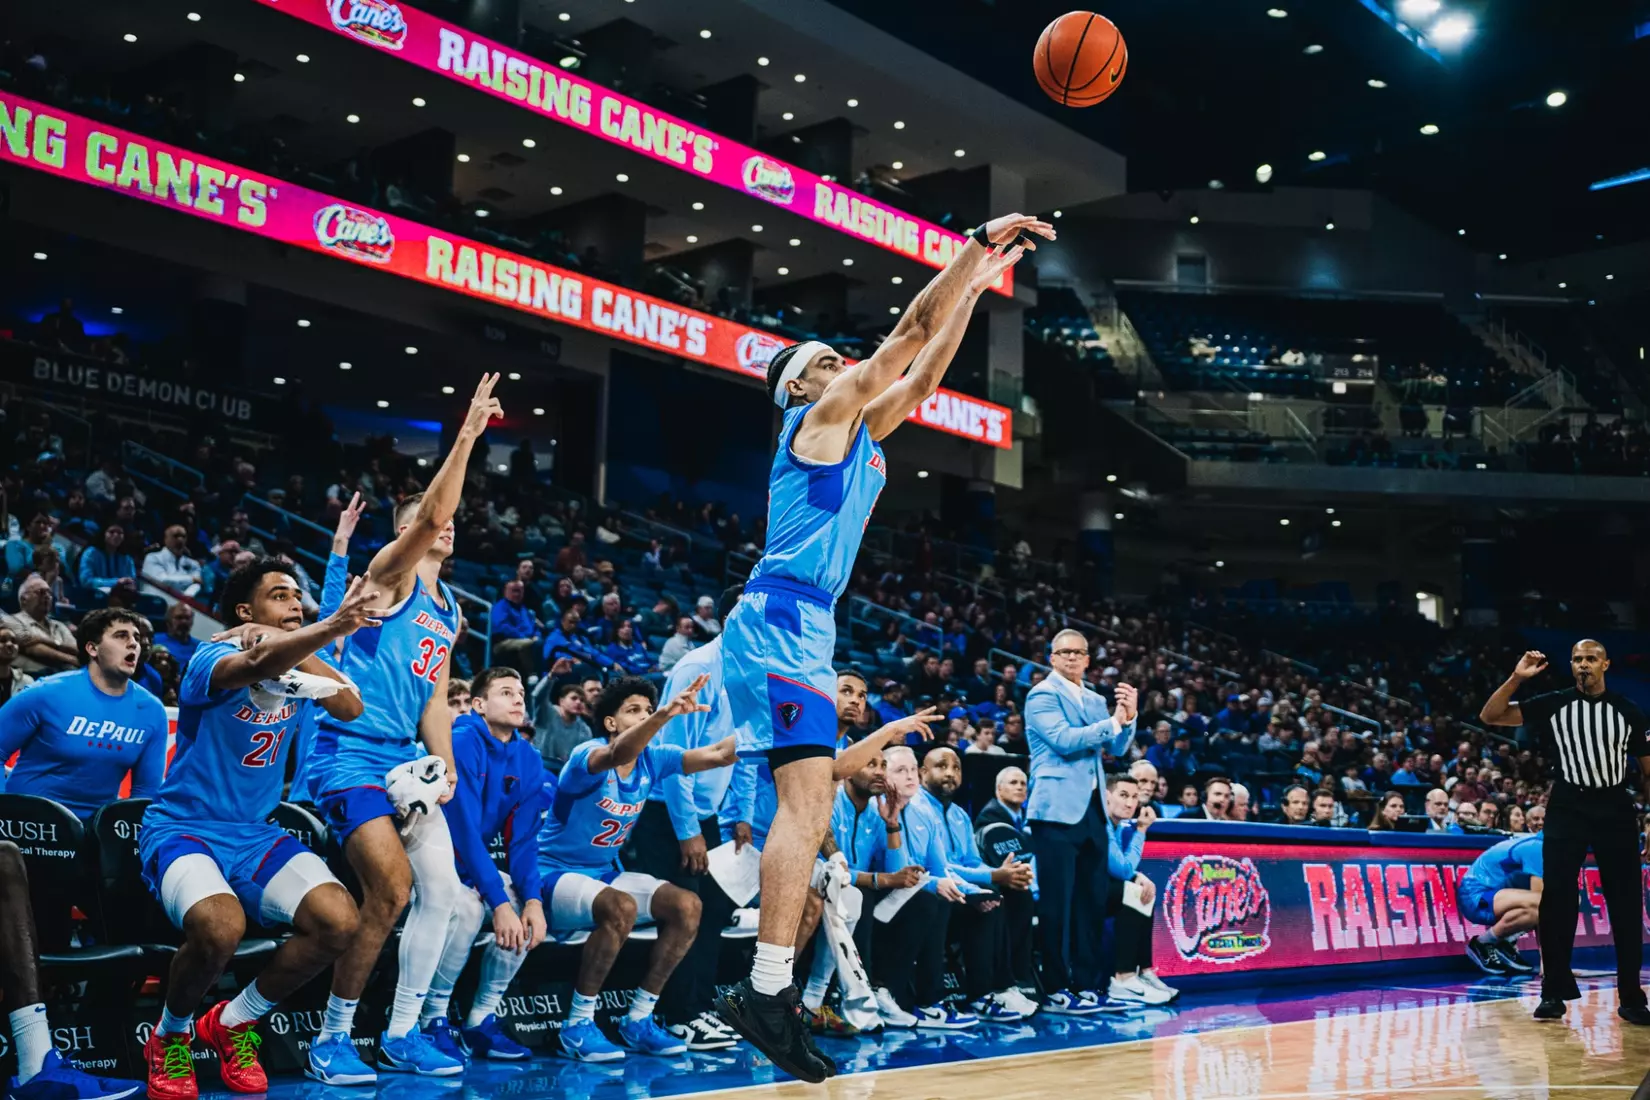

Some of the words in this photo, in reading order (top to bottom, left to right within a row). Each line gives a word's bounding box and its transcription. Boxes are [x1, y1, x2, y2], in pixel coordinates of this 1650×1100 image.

[437, 28, 592, 126] RAISING
[600, 93, 713, 174] CANE'S
[86, 131, 268, 228] CANE'S
[814, 182, 919, 254] RAISING
[426, 236, 583, 320] RAISING
[591, 287, 707, 356] CANE'S
[33, 357, 99, 389] BLUE
[107, 371, 190, 405] DEMON
[411, 636, 449, 684] 32
[241, 726, 287, 768] 21
[35, 846, 76, 859] Therapy
[507, 994, 563, 1017] RUSH
[602, 989, 636, 1010] RUS
[515, 1020, 547, 1032] Physical
